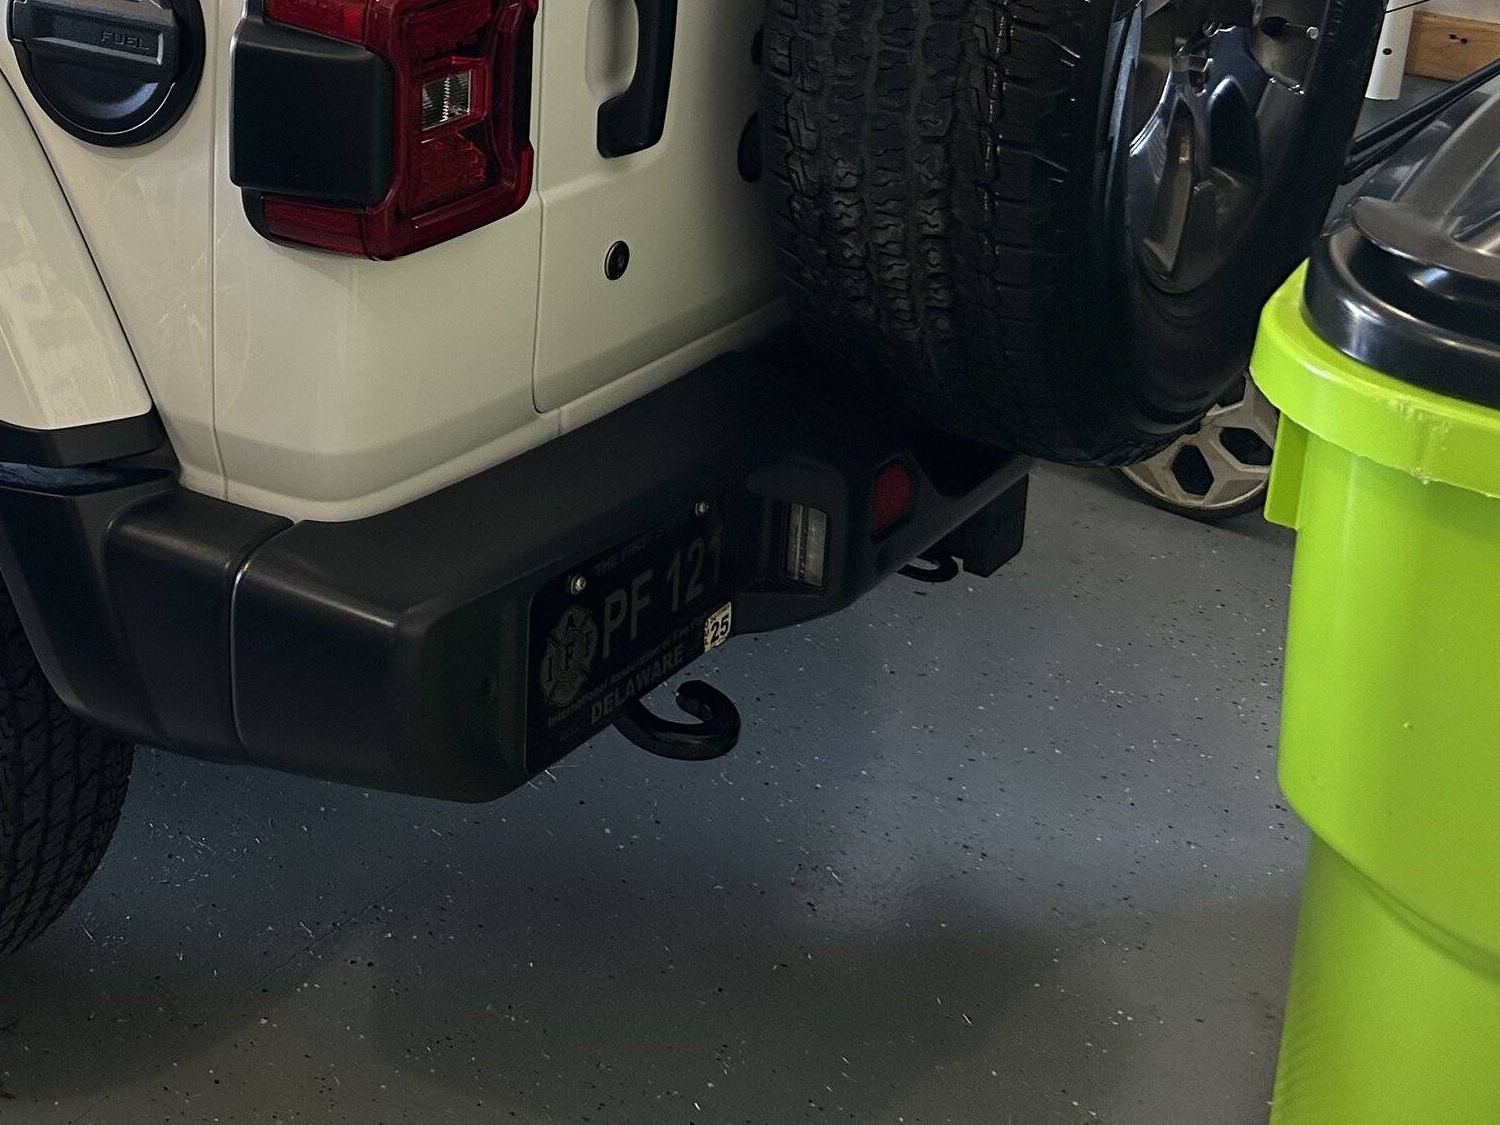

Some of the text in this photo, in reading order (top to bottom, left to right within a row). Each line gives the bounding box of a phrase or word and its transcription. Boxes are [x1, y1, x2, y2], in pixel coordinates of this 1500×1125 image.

[100, 31, 150, 51] FUEL
[602, 567, 654, 660] PF
[709, 613, 729, 645] 25
[590, 641, 684, 725] DELAWARE
